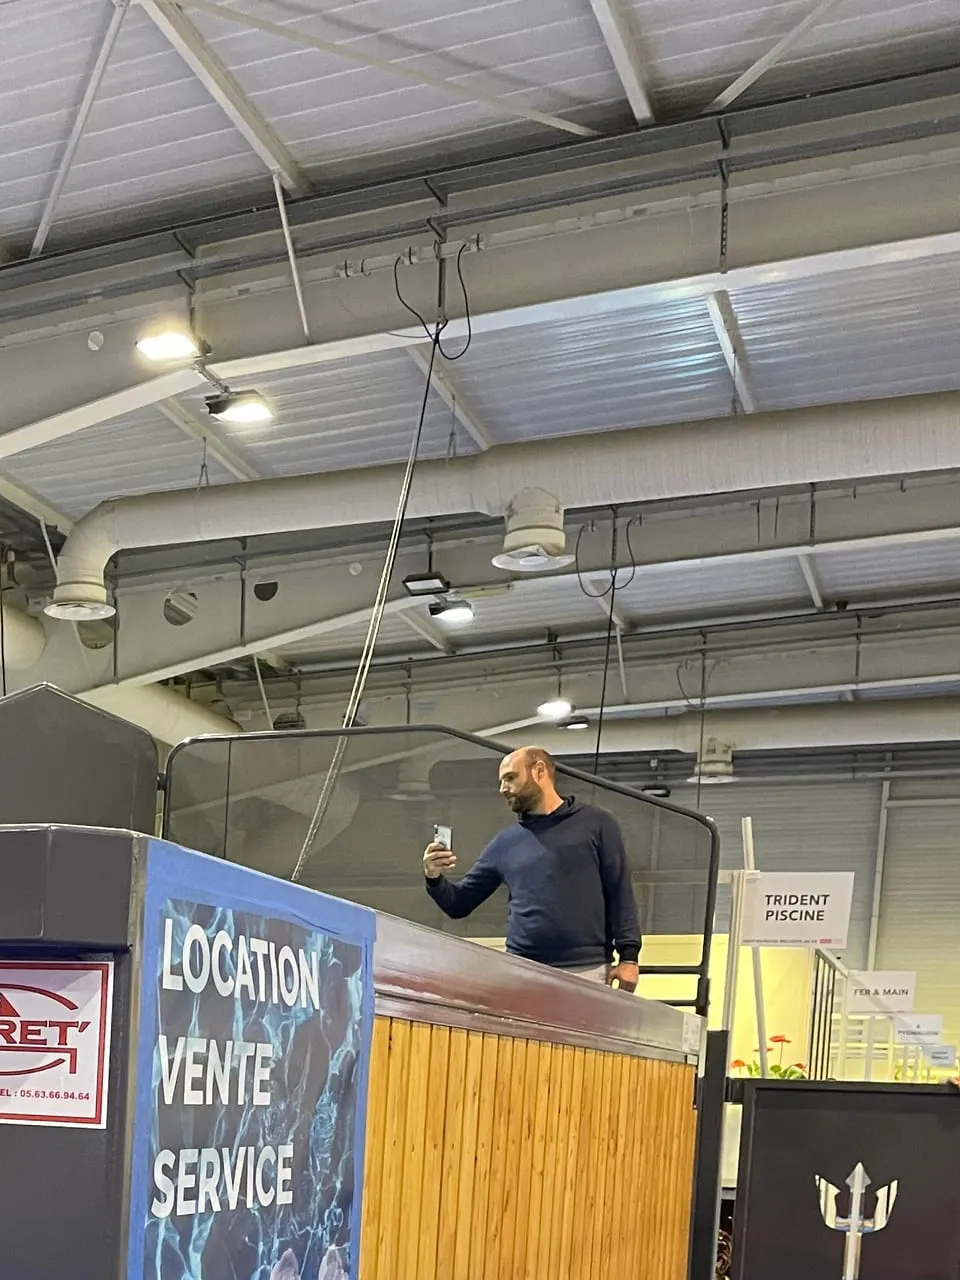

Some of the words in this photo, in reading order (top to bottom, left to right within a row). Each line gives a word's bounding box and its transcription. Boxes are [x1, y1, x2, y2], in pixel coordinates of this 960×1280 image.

[764, 894, 830, 906] TRIDENT
[765, 910, 825, 921] PISCINE
[162, 918, 321, 1010] LOCATION
[854, 988, 871, 996] FER
[882, 988, 909, 996] MAIN
[158, 1035, 274, 1106] VENTE
[20, 1089, 90, 1101] 05.63.66.94.64
[151, 1142, 294, 1219] SERVICE
